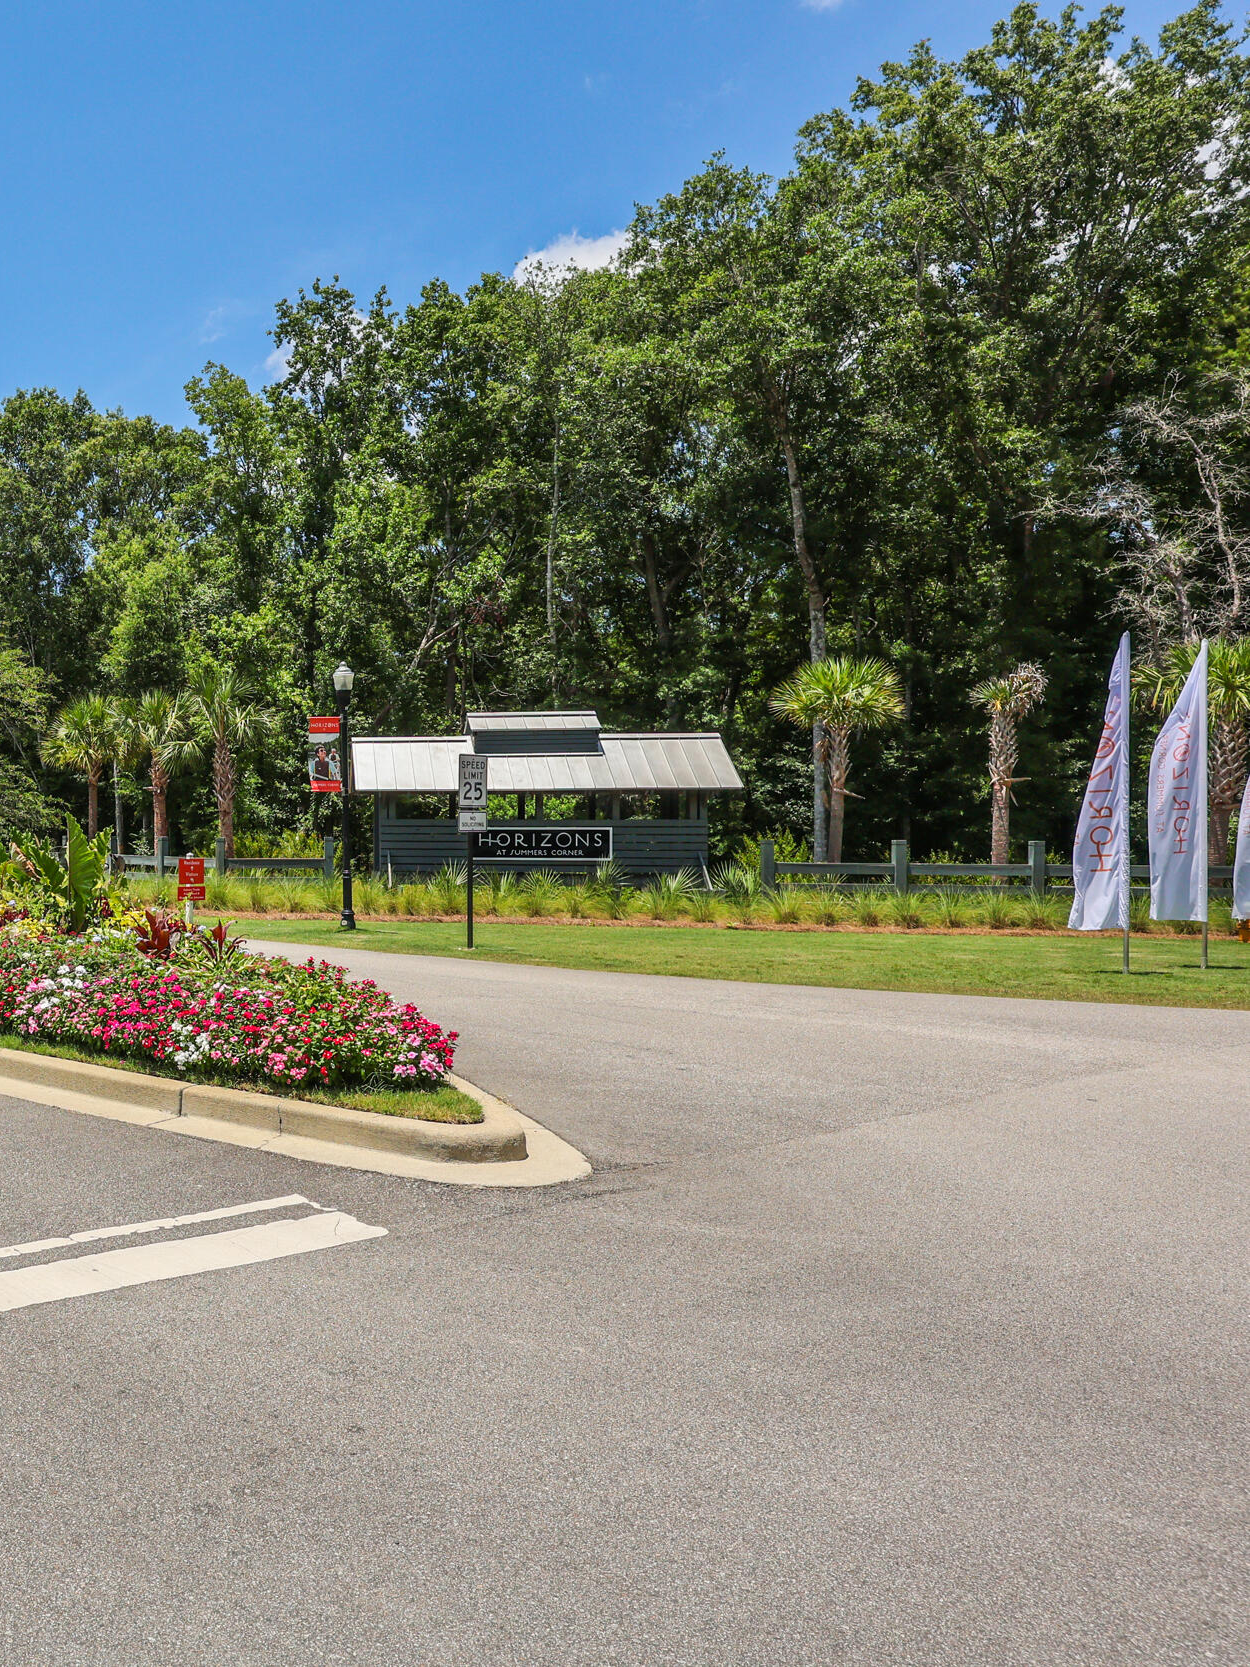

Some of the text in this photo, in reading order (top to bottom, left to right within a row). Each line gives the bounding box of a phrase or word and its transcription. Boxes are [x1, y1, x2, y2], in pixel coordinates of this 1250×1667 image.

[461, 760, 486, 770] SPEED
[463, 771, 484, 780] LIMIT
[463, 781, 483, 801] 25
[478, 832, 603, 848] HORIZONS
